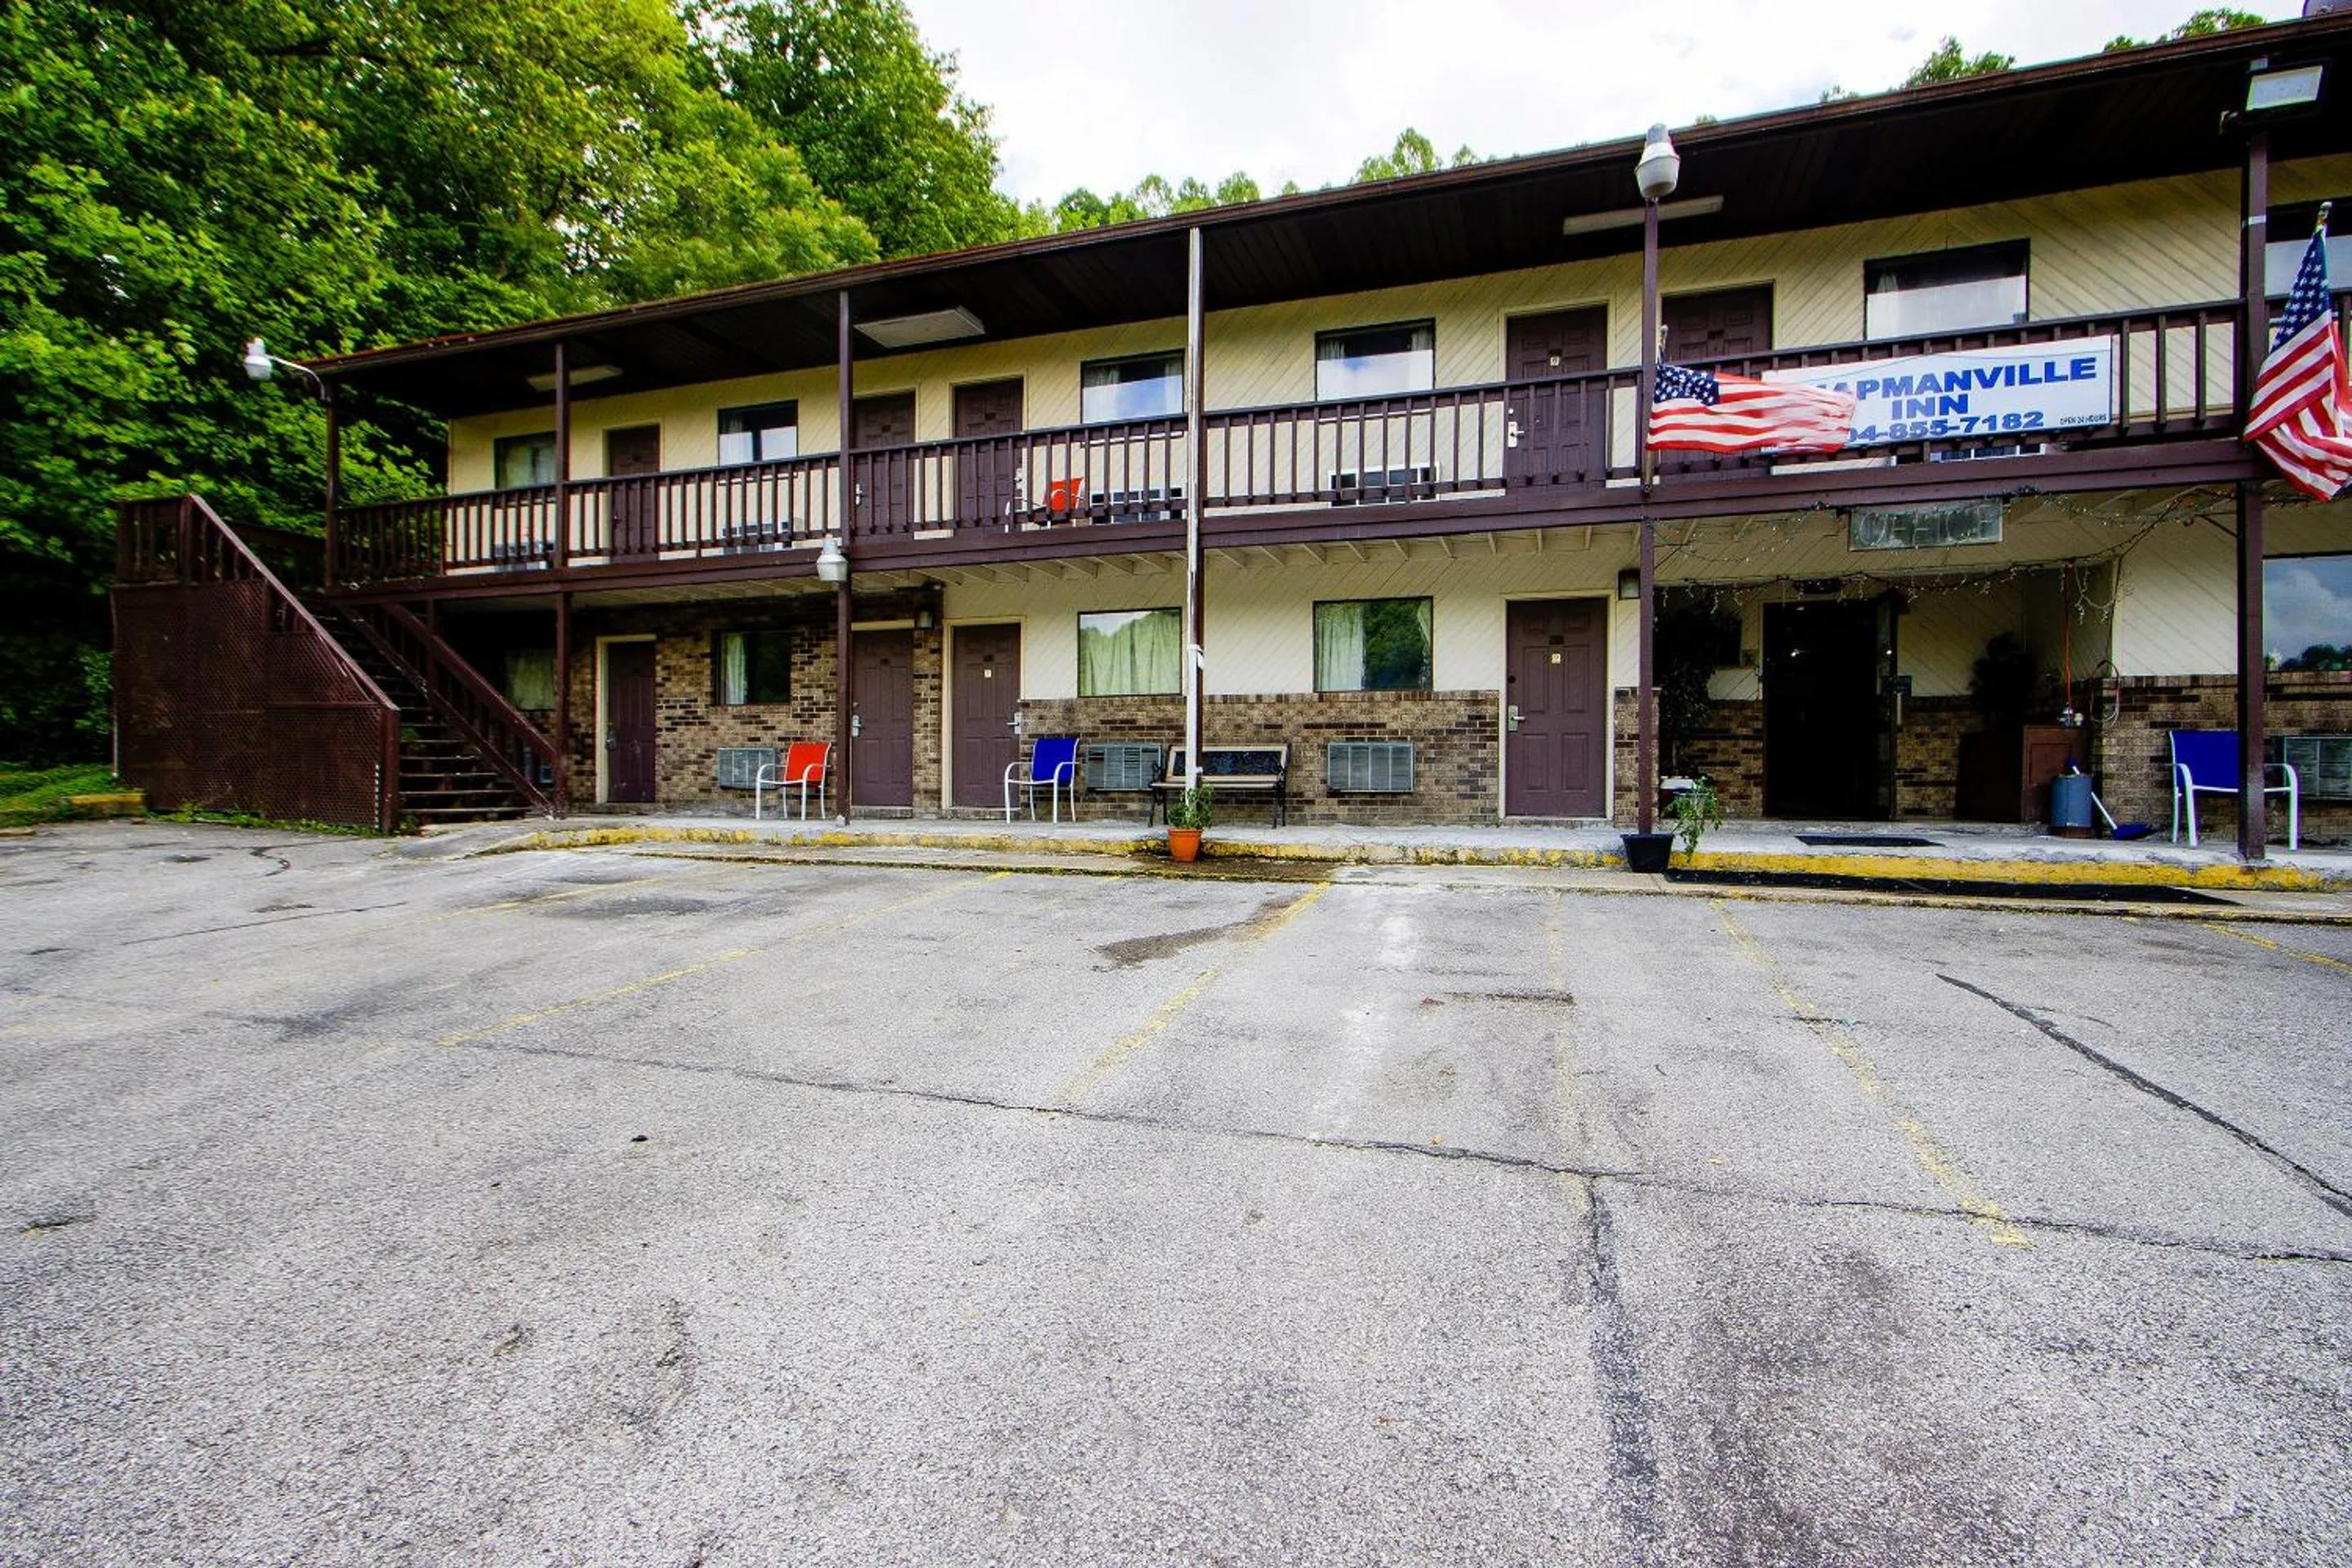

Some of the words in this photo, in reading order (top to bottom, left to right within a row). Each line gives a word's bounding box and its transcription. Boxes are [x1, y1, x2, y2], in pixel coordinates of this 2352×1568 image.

[1816, 357, 2096, 400] PMANVILLE
[1892, 394, 1969, 420] INN
[2077, 415, 2085, 424] 24
[2085, 413, 2106, 423] HOURS
[1850, 411, 2044, 443] 4-855-7182
